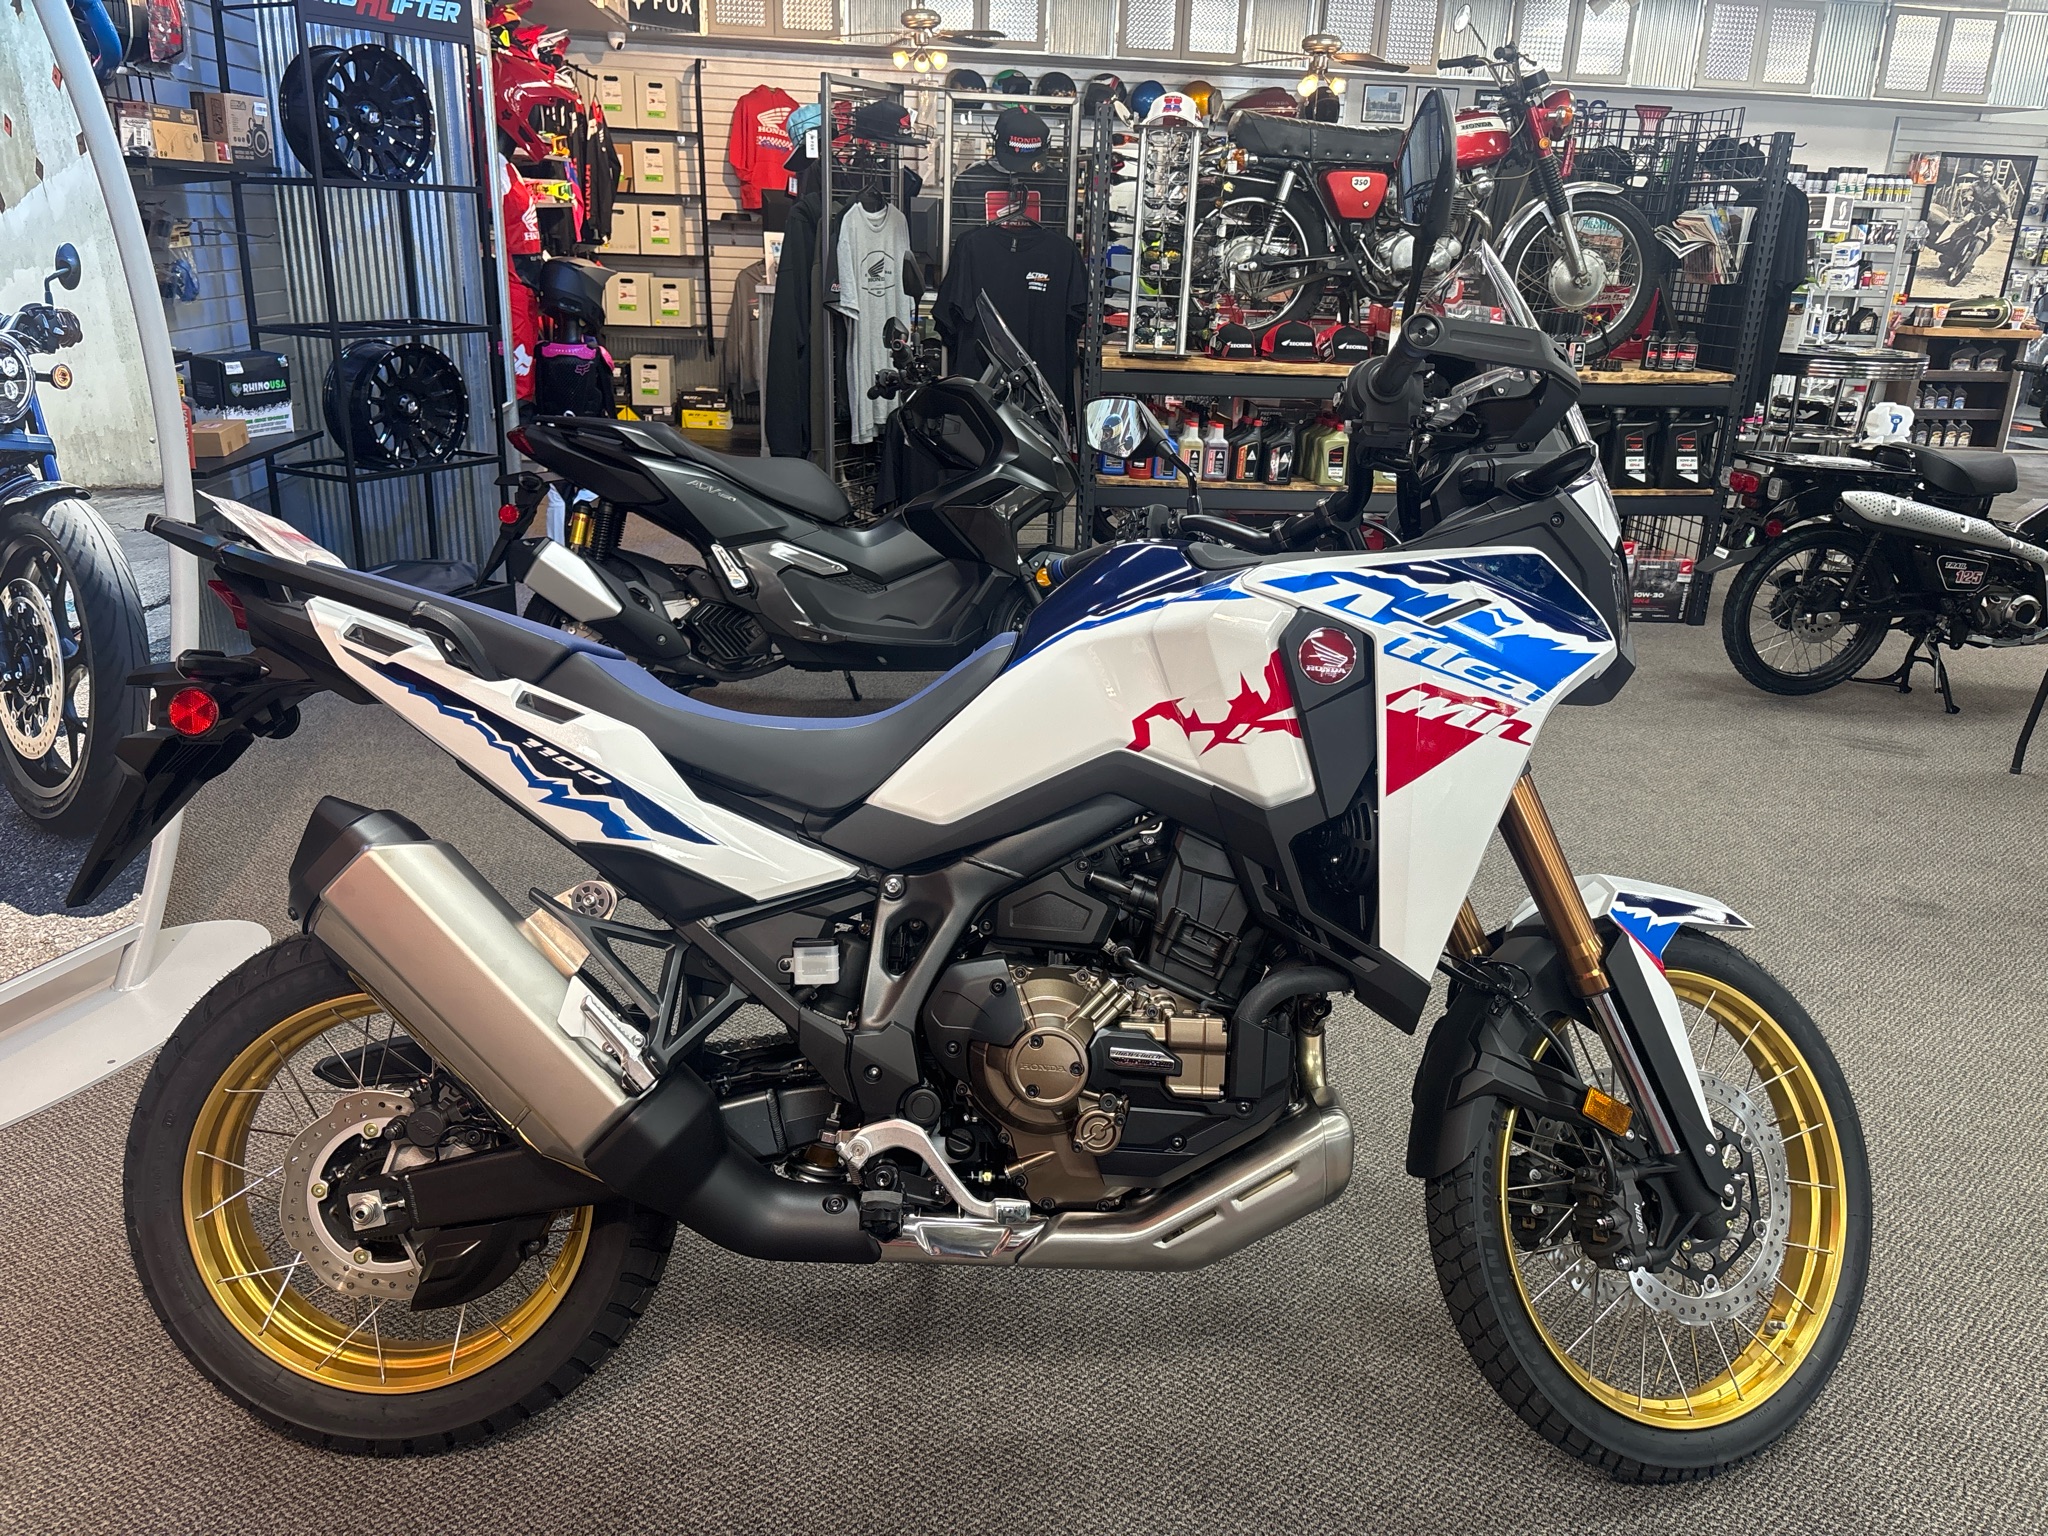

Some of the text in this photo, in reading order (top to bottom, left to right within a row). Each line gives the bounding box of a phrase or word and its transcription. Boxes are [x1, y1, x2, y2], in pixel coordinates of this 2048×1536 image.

[1460, 121, 1494, 130] HONDA
[1009, 135, 1042, 144] HONDA
[1354, 178, 1369, 187] 350
[1945, 561, 1967, 570] TRAIL
[1955, 570, 1984, 585] 125
[1306, 664, 1347, 674] HONDA
[522, 737, 612, 785] 1100
[1020, 1062, 1067, 1073] HONDA
[1487, 1109, 1499, 1135] 21
[1482, 1155, 1493, 1223] 90/90
[1633, 1202, 1645, 1234] NISSIN
